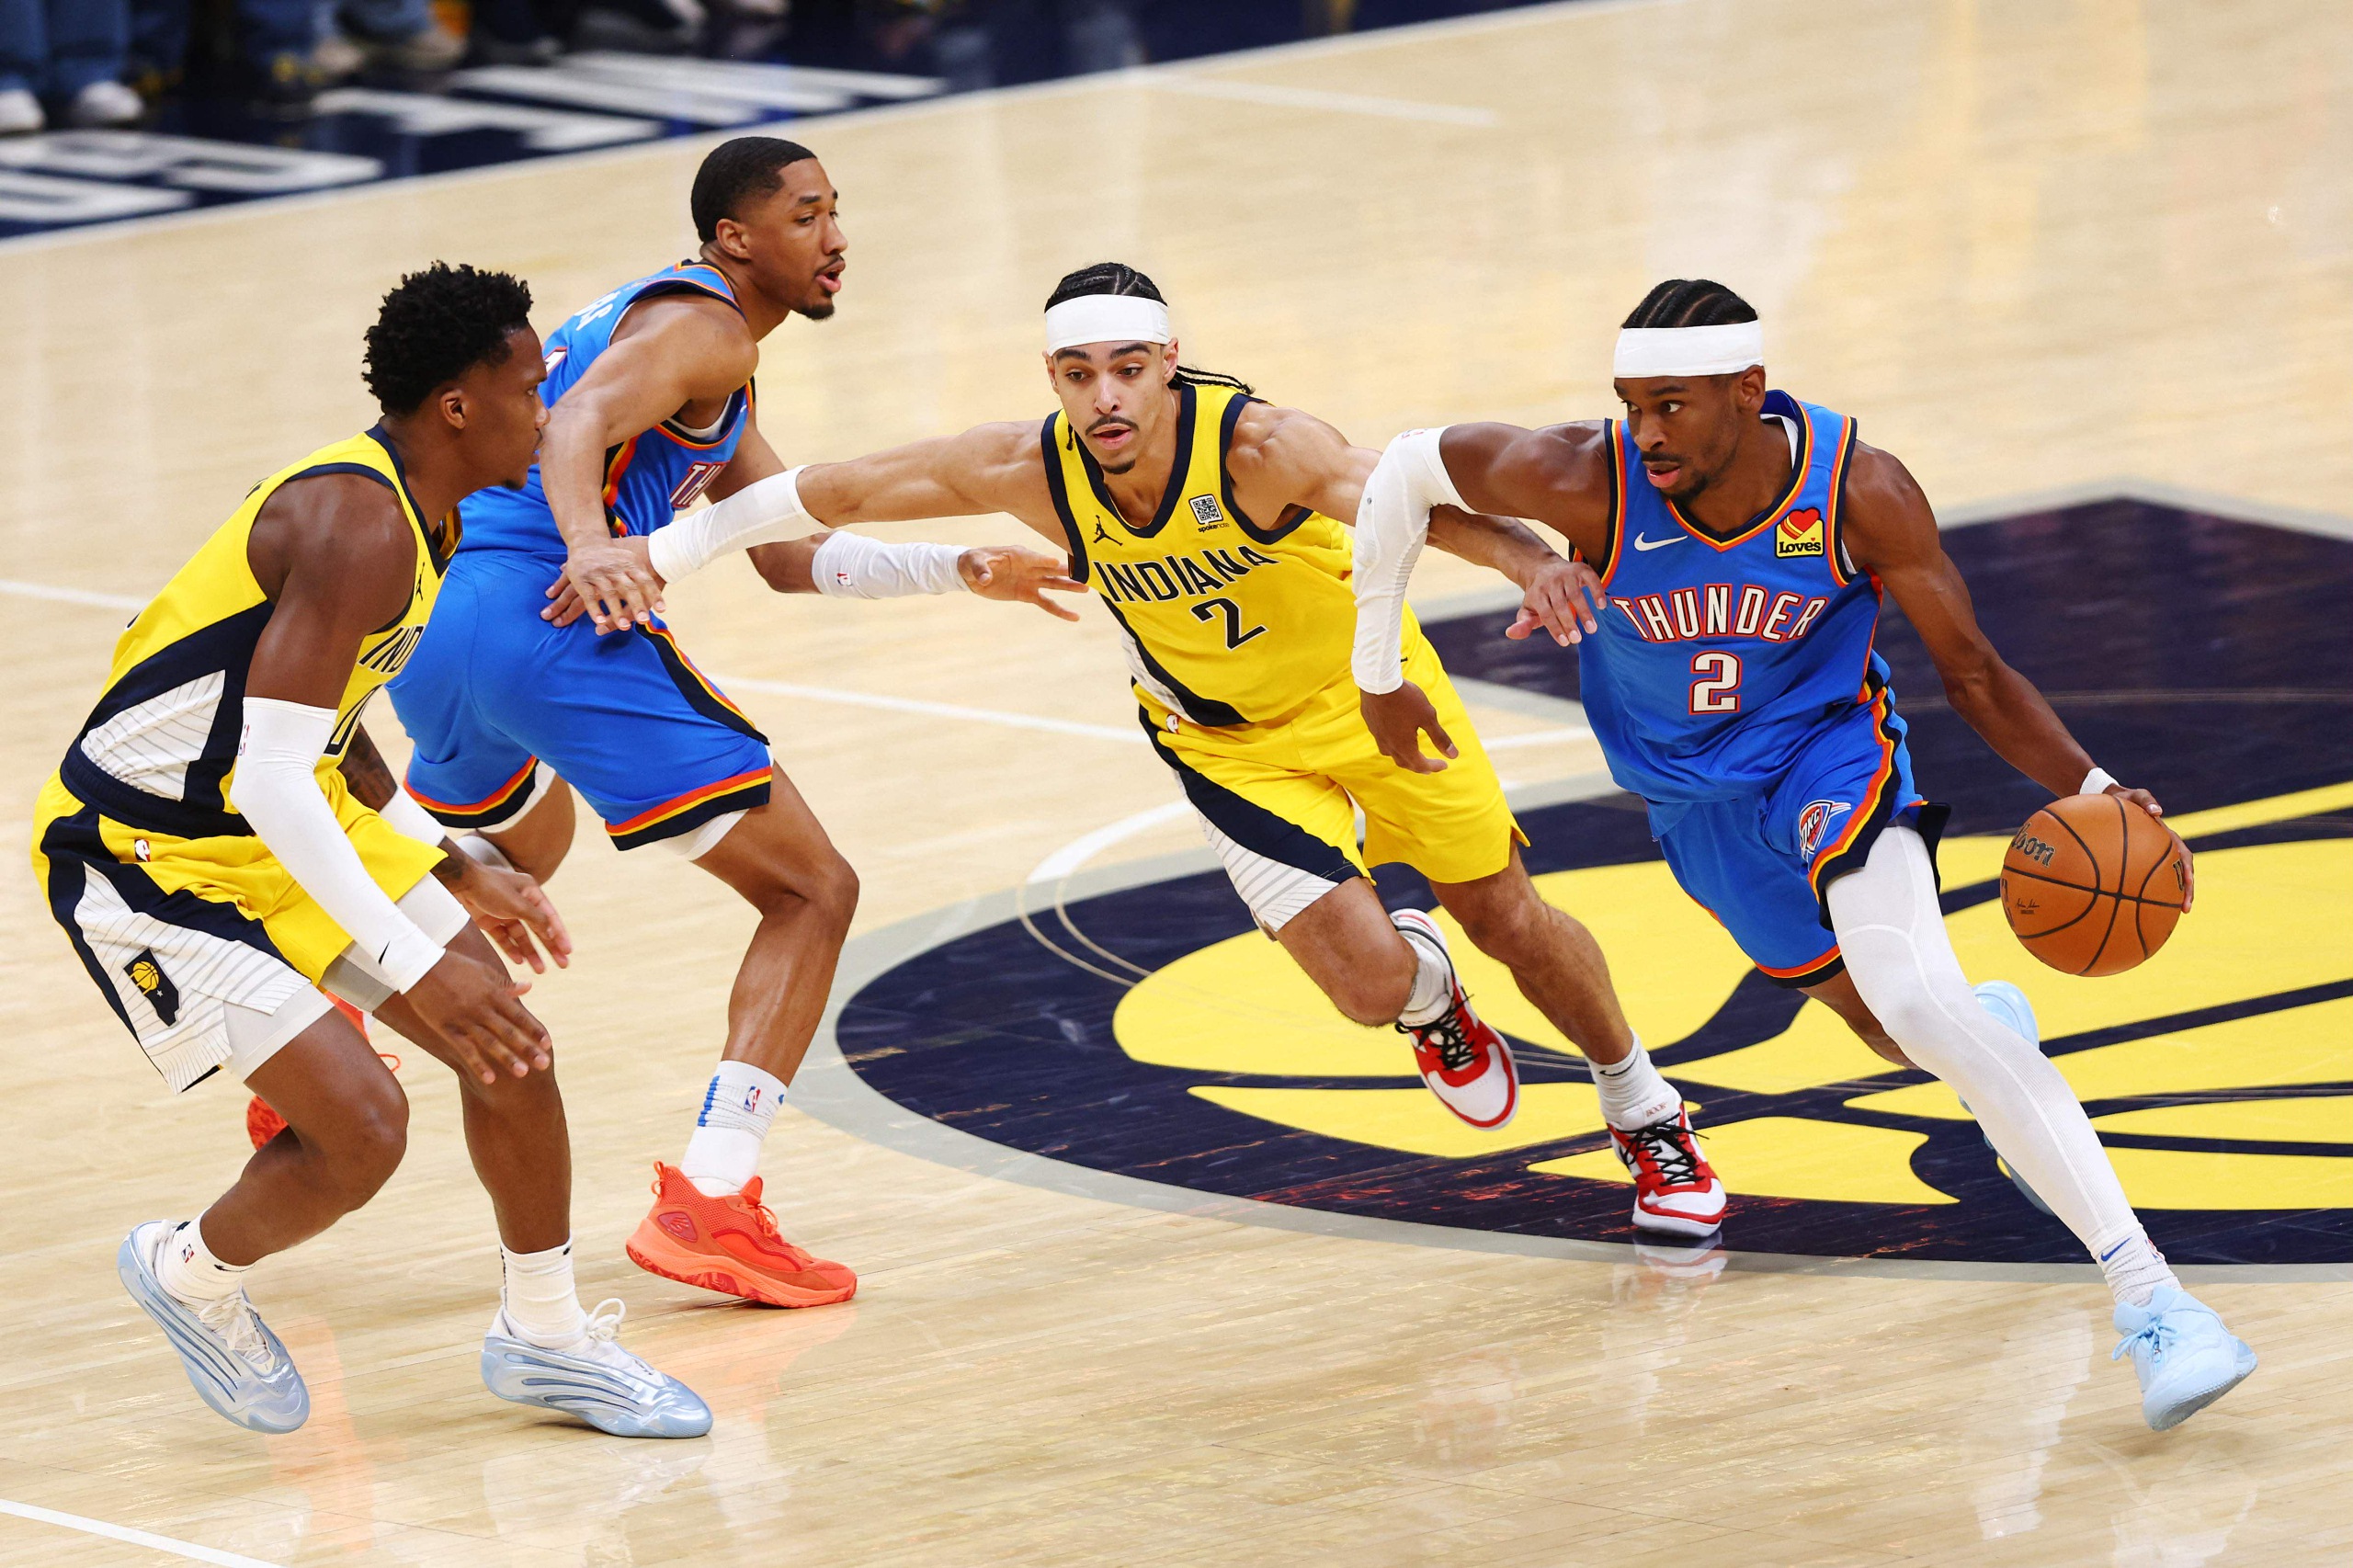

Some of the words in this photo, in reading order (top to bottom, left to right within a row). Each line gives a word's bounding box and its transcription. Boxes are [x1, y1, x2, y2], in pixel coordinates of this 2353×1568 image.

[1092, 545, 1280, 603] INDIANA
[1189, 597, 1269, 651] 2
[1610, 583, 1830, 644] THUNDER
[1688, 650, 1743, 715] 2
